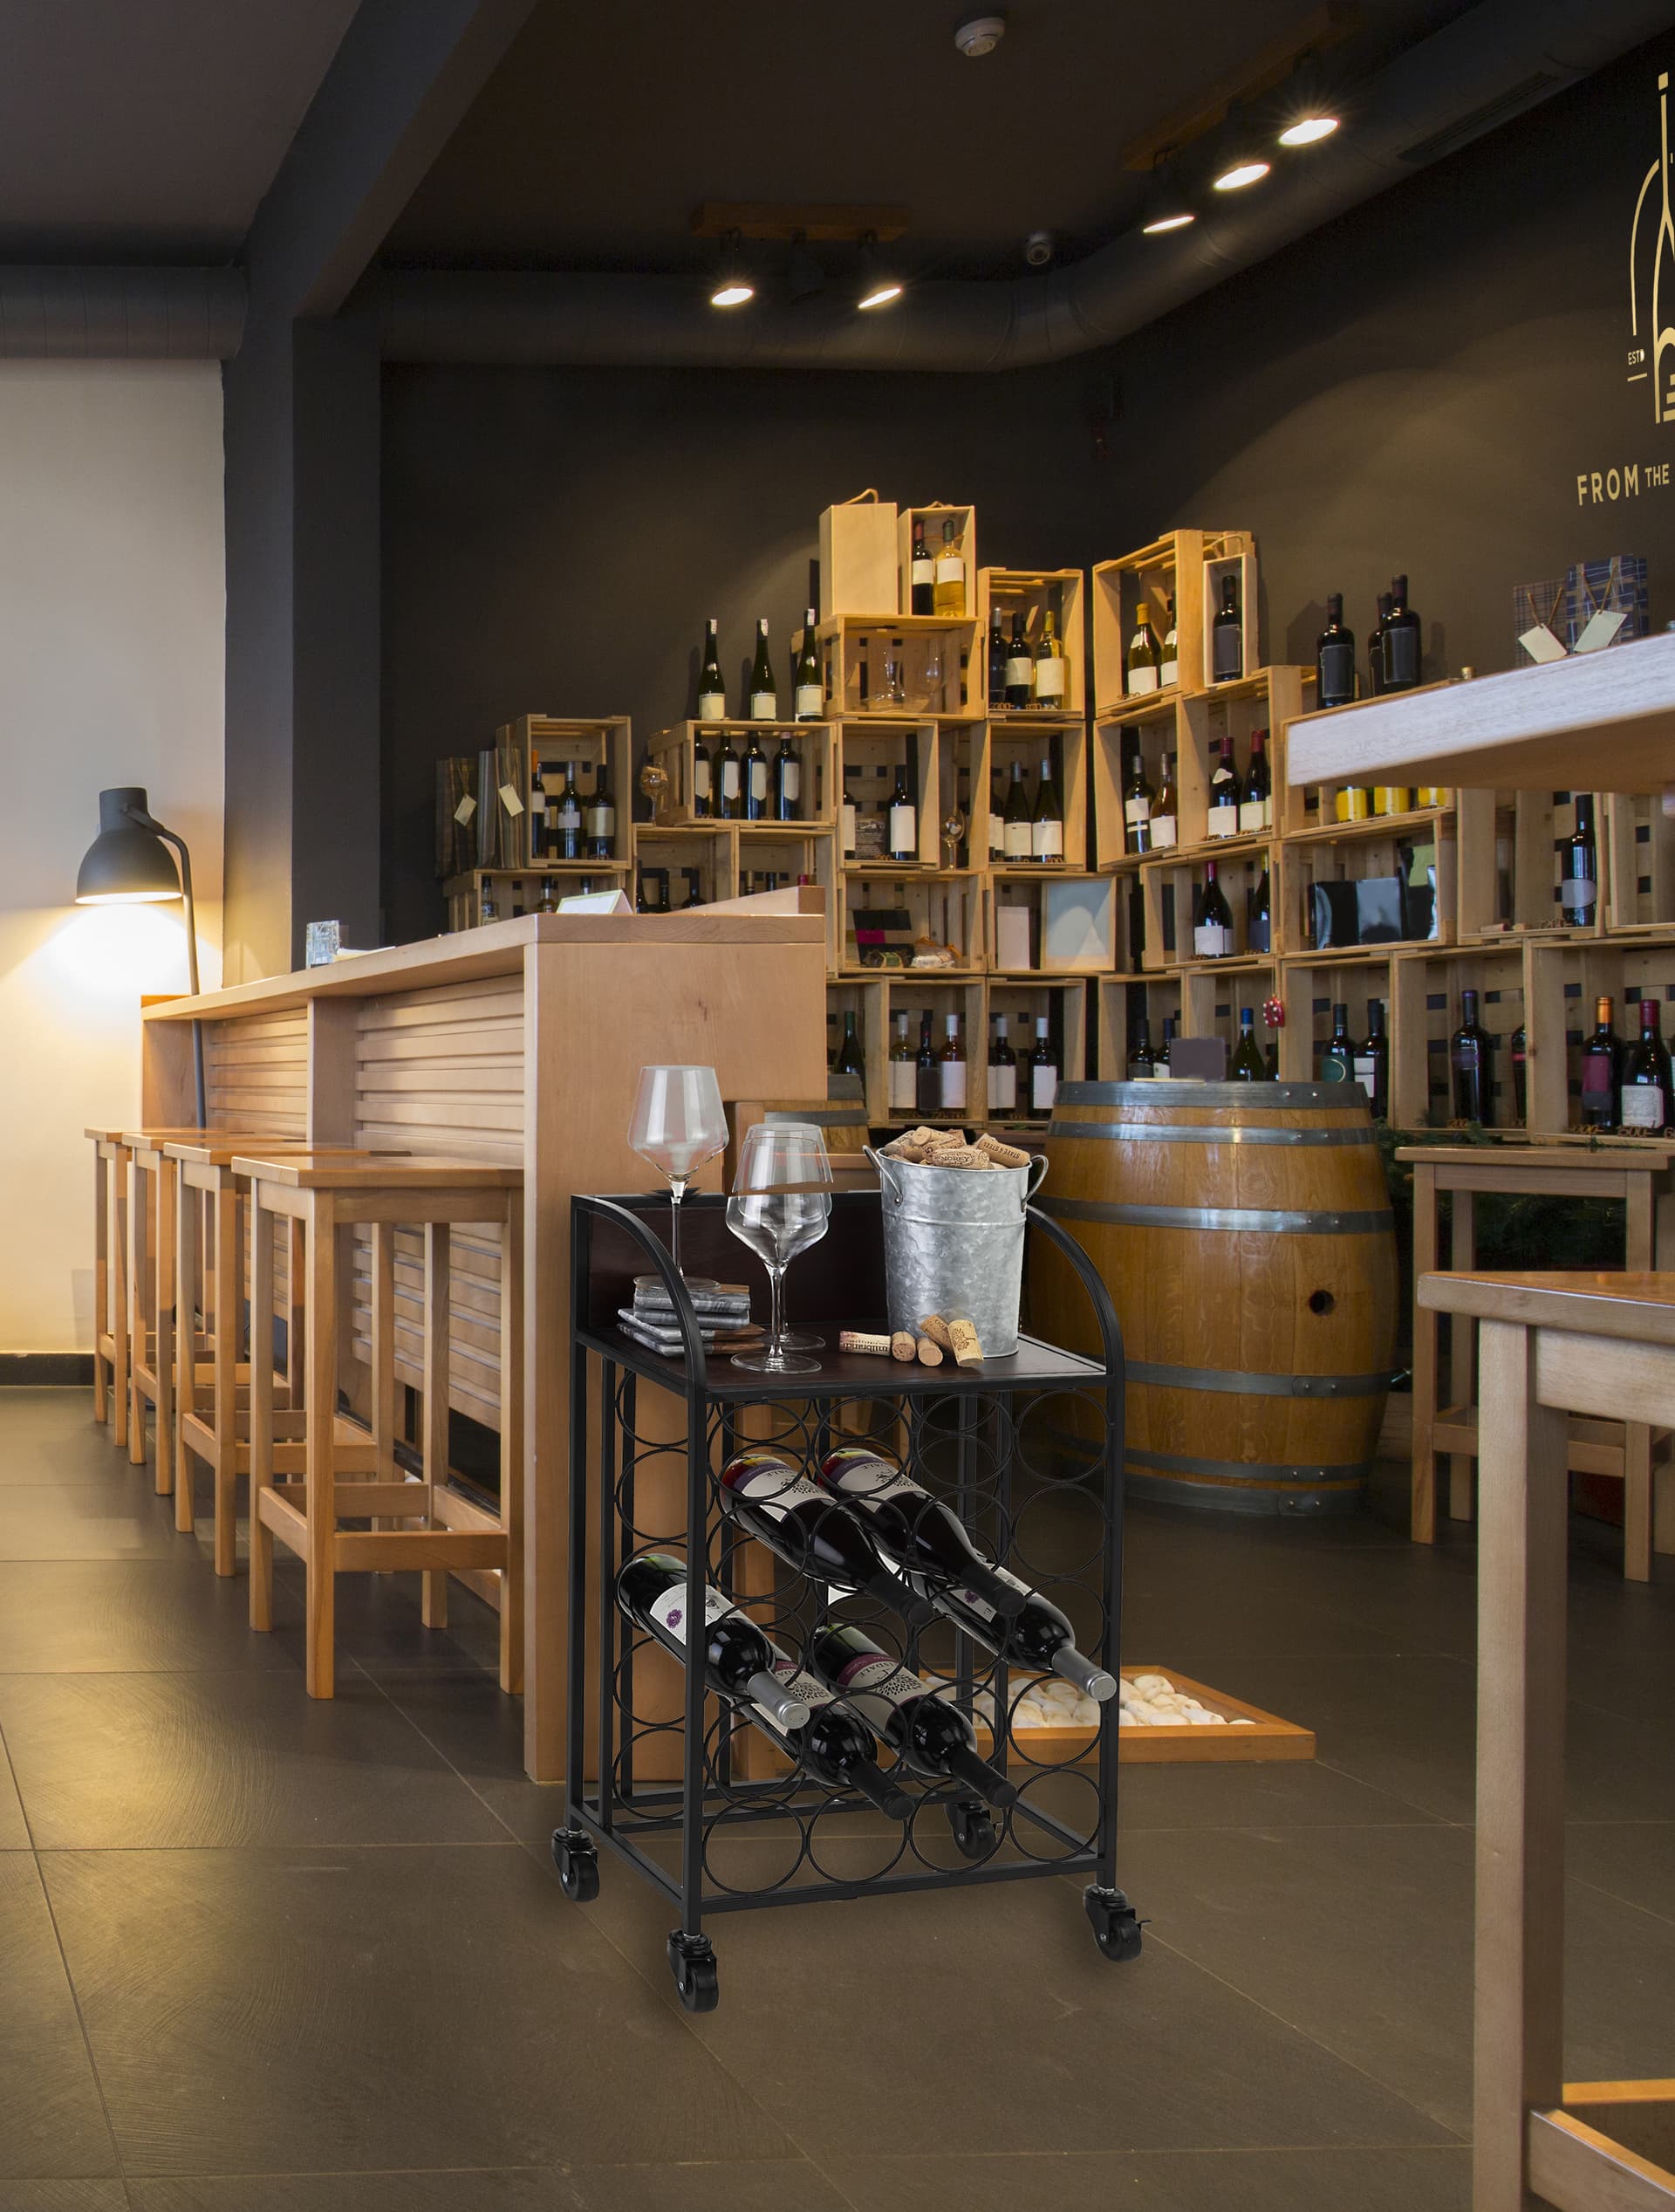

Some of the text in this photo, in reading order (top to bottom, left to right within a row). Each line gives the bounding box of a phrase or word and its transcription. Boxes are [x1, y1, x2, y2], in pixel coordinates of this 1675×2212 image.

[1576, 463, 1670, 506] FROM THE
[983, 1140, 1000, 1151] STEEL
[1002, 1148, 1021, 1160] STAVE
